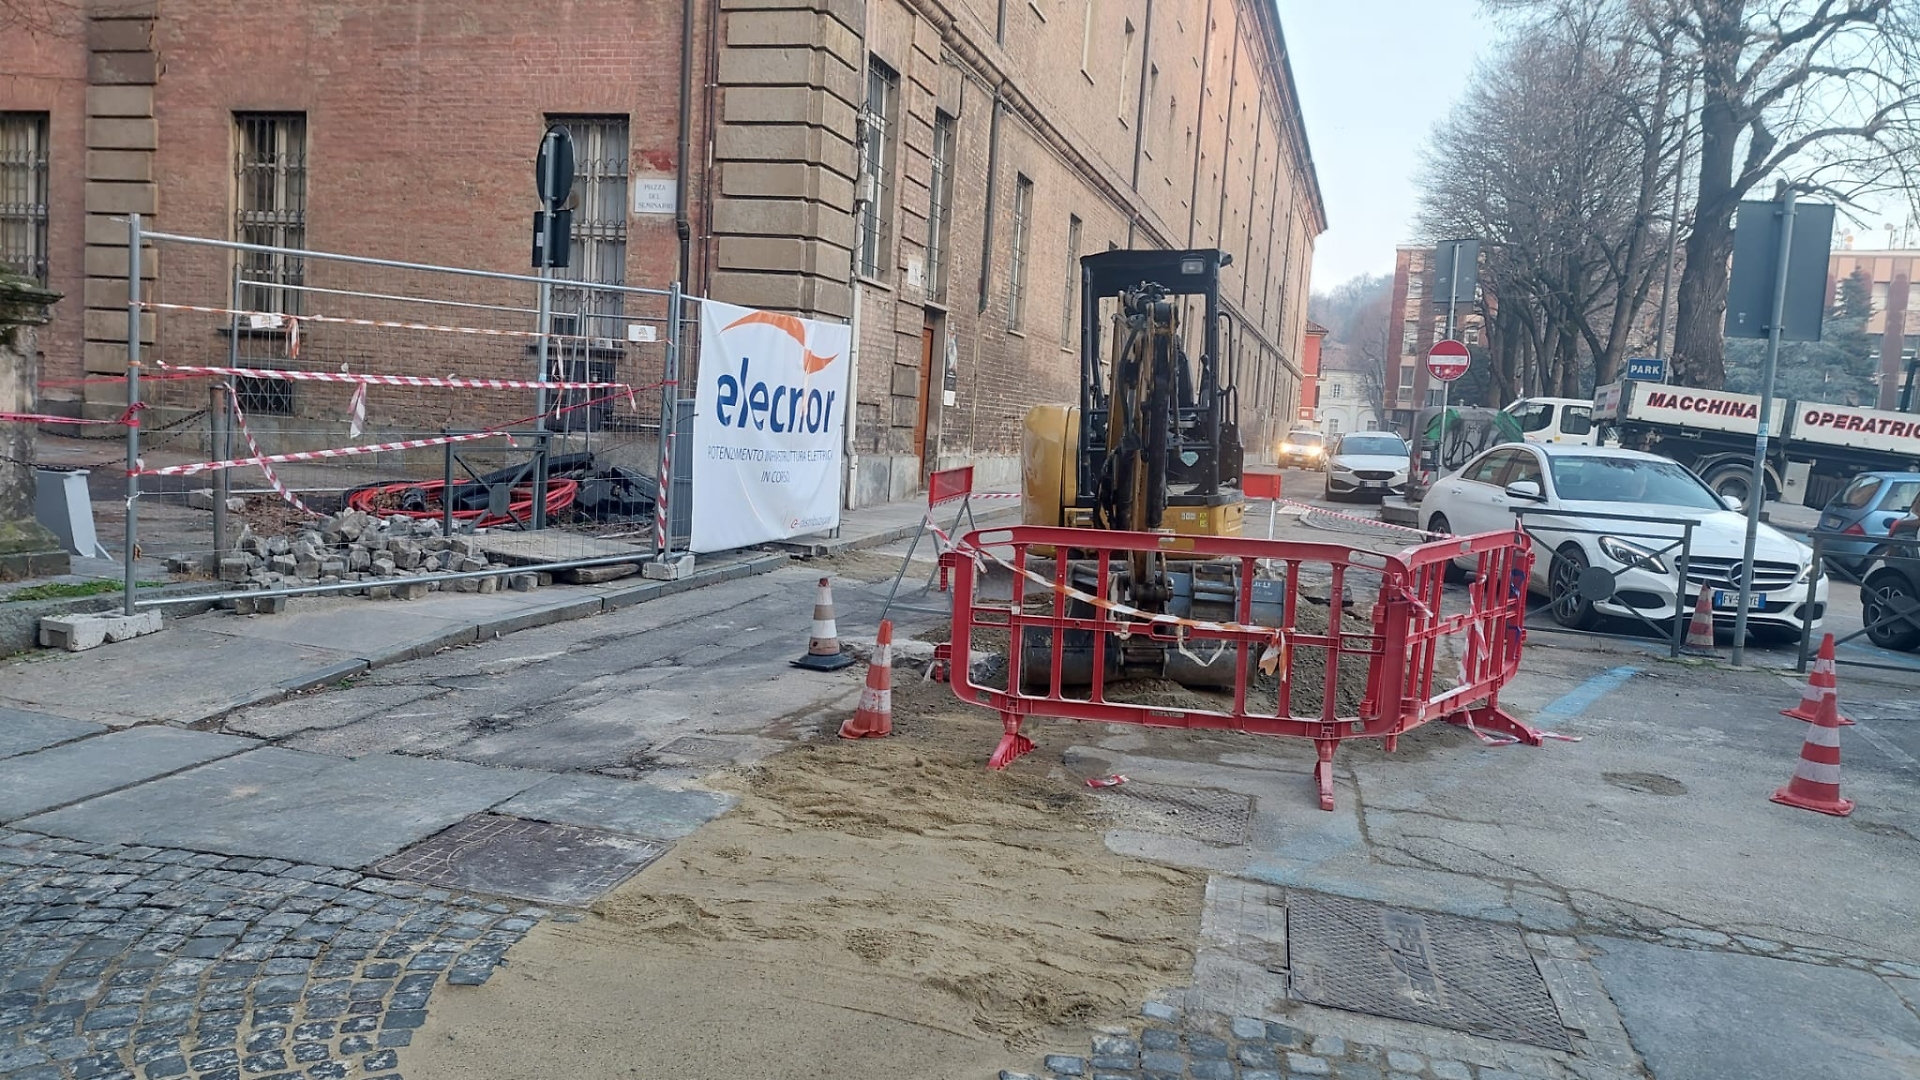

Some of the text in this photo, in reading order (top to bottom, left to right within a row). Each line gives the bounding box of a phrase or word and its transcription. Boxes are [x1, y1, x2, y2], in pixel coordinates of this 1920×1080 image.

[1630, 364, 1661, 374] PARK
[716, 357, 835, 434] elecnor
[1646, 392, 1757, 419] MACCHINA
[760, 471, 770, 482] IN
